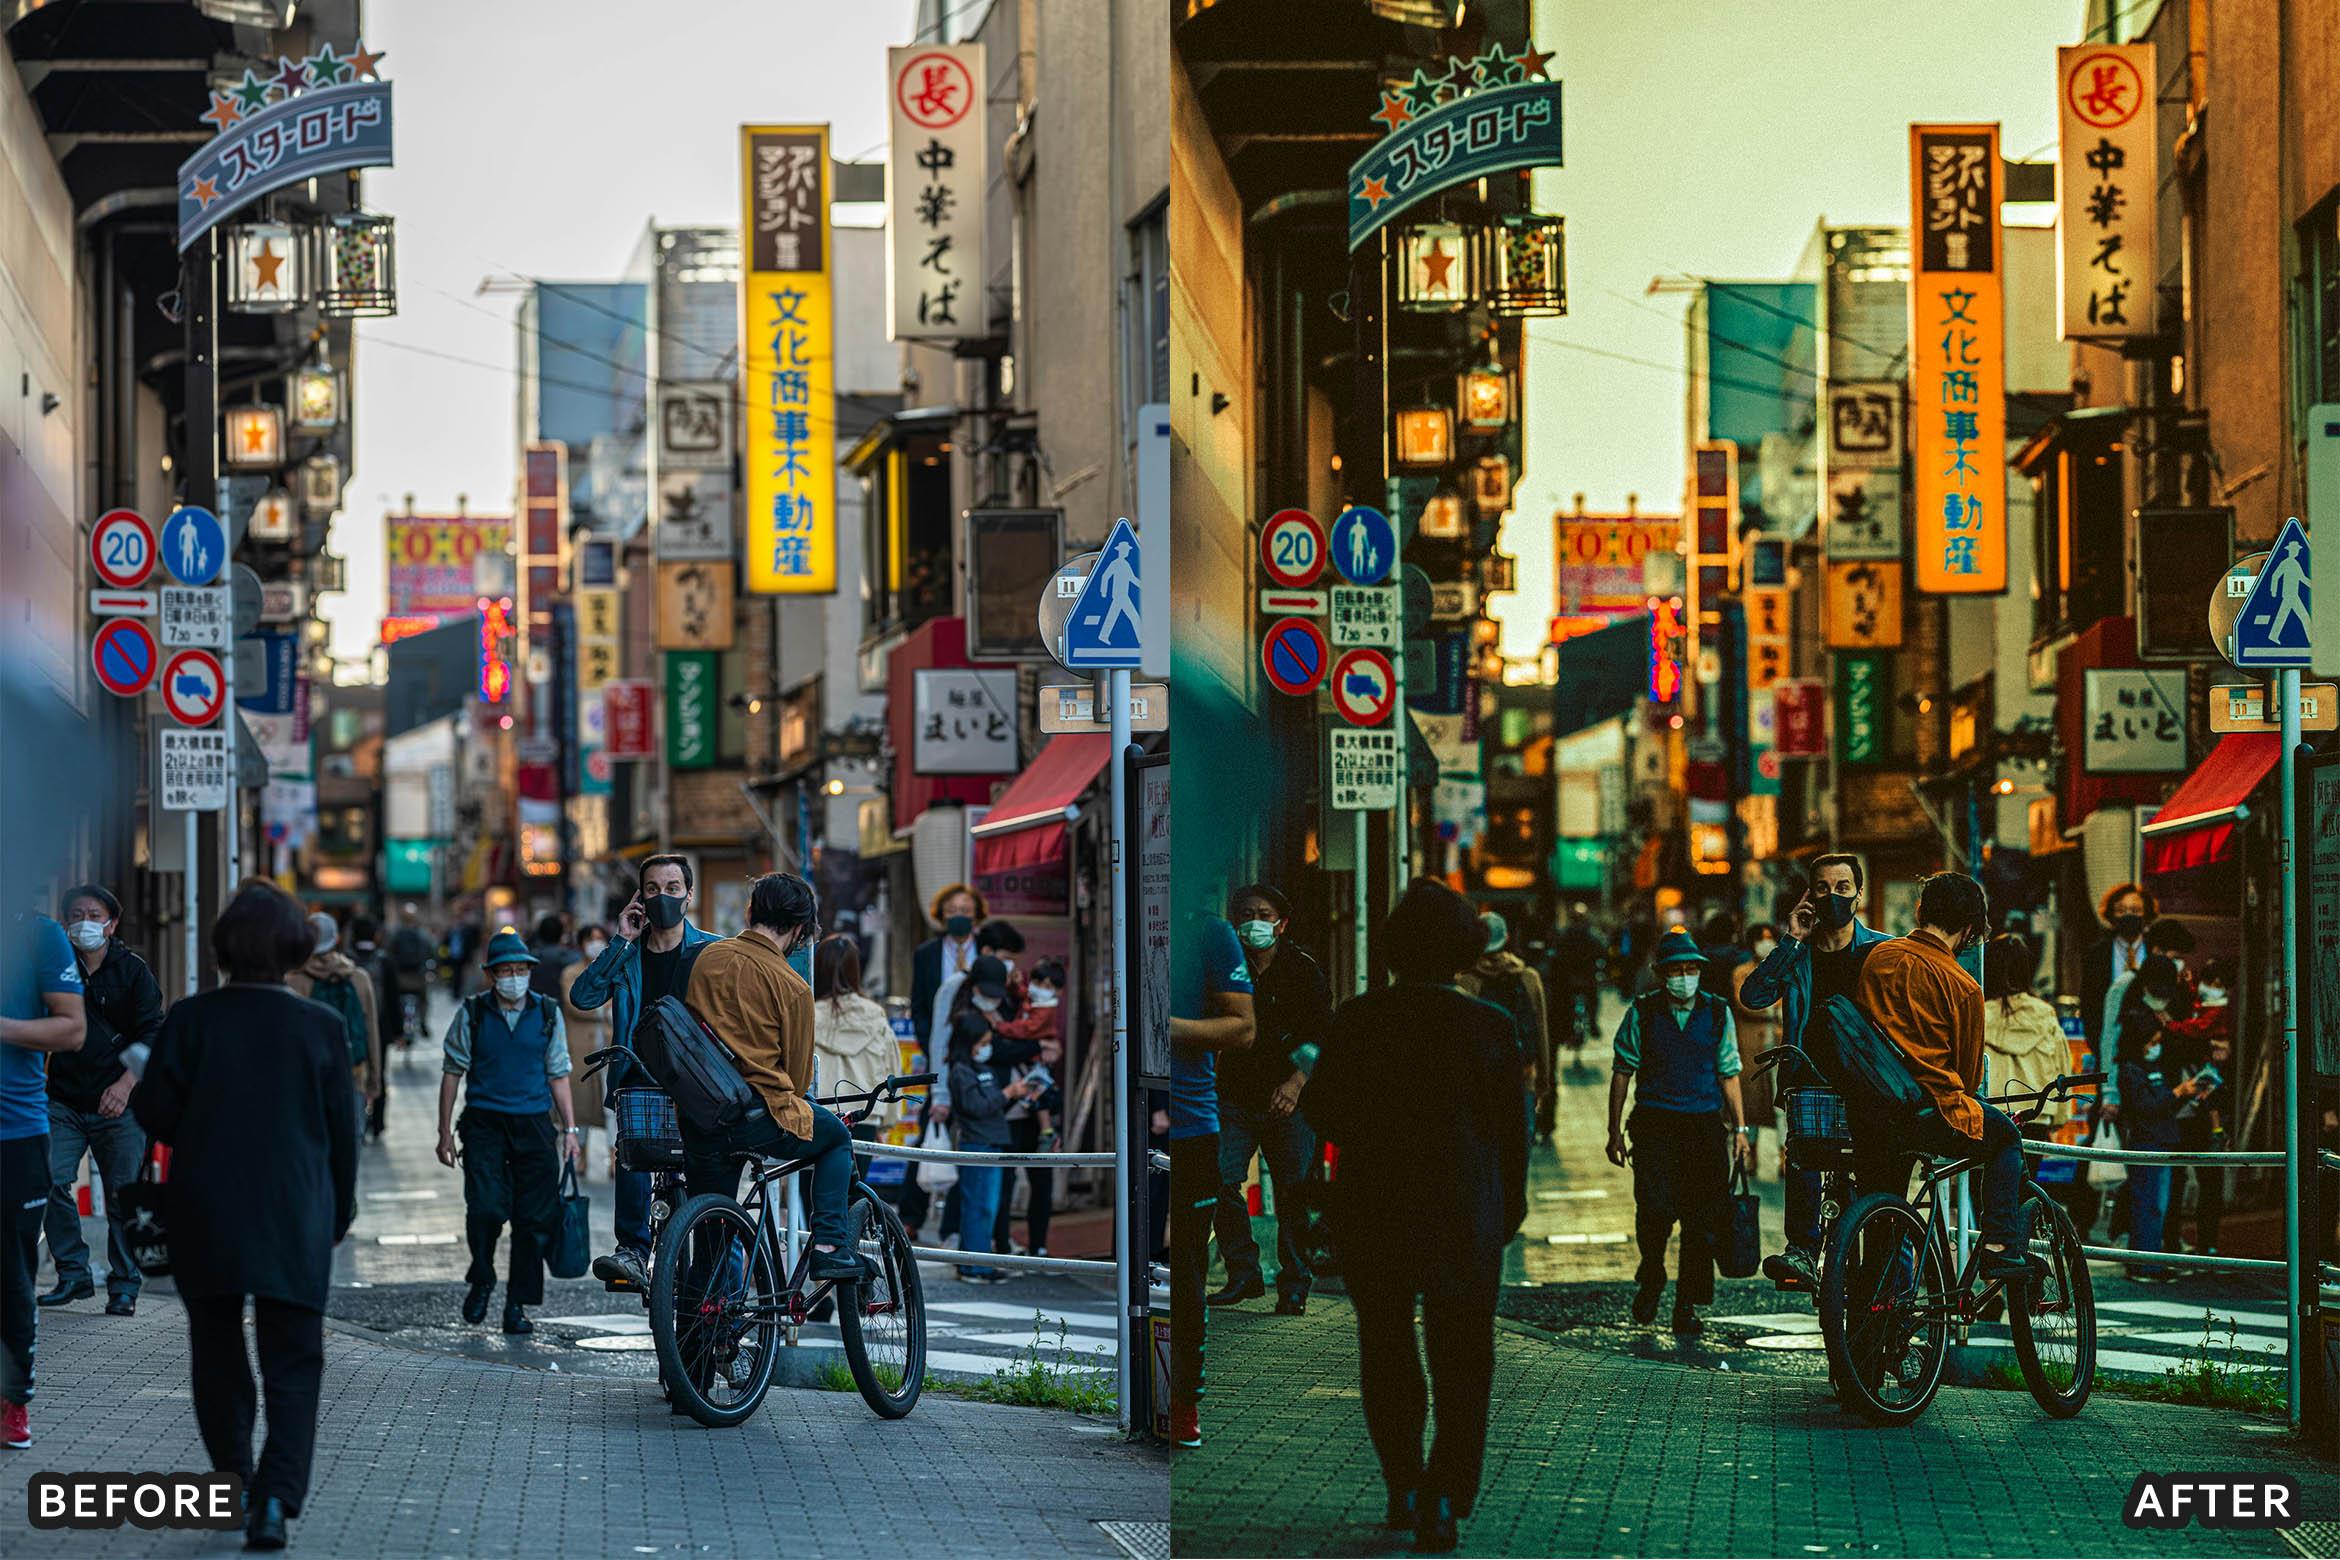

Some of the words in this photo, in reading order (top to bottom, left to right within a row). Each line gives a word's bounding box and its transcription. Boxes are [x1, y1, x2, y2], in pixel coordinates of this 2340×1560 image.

[218, 97, 381, 191] スターロード
[1388, 97, 1551, 191] スターロード
[915, 140, 962, 327] 中華そば
[2085, 140, 2132, 327] 中華そば
[767, 287, 813, 577] 文化商事不動産
[1937, 287, 1983, 577] 文化商事不動産
[106, 531, 143, 566] 20
[1276, 531, 1313, 566] 20
